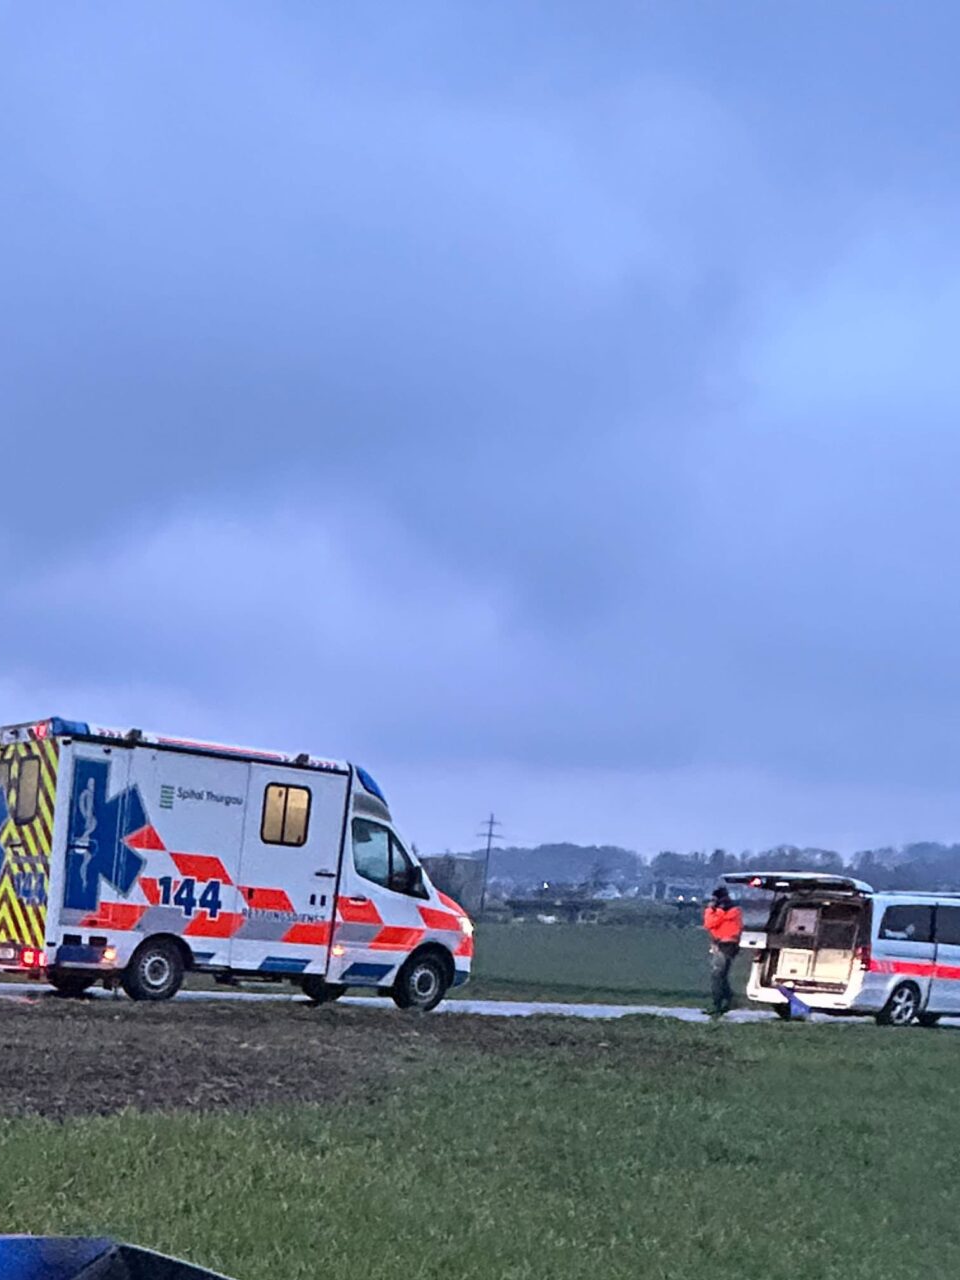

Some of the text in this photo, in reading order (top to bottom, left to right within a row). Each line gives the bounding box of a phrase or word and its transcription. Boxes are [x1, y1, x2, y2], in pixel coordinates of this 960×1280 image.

[176, 785, 244, 807] Spital Thurgau
[158, 875, 223, 919] 144
